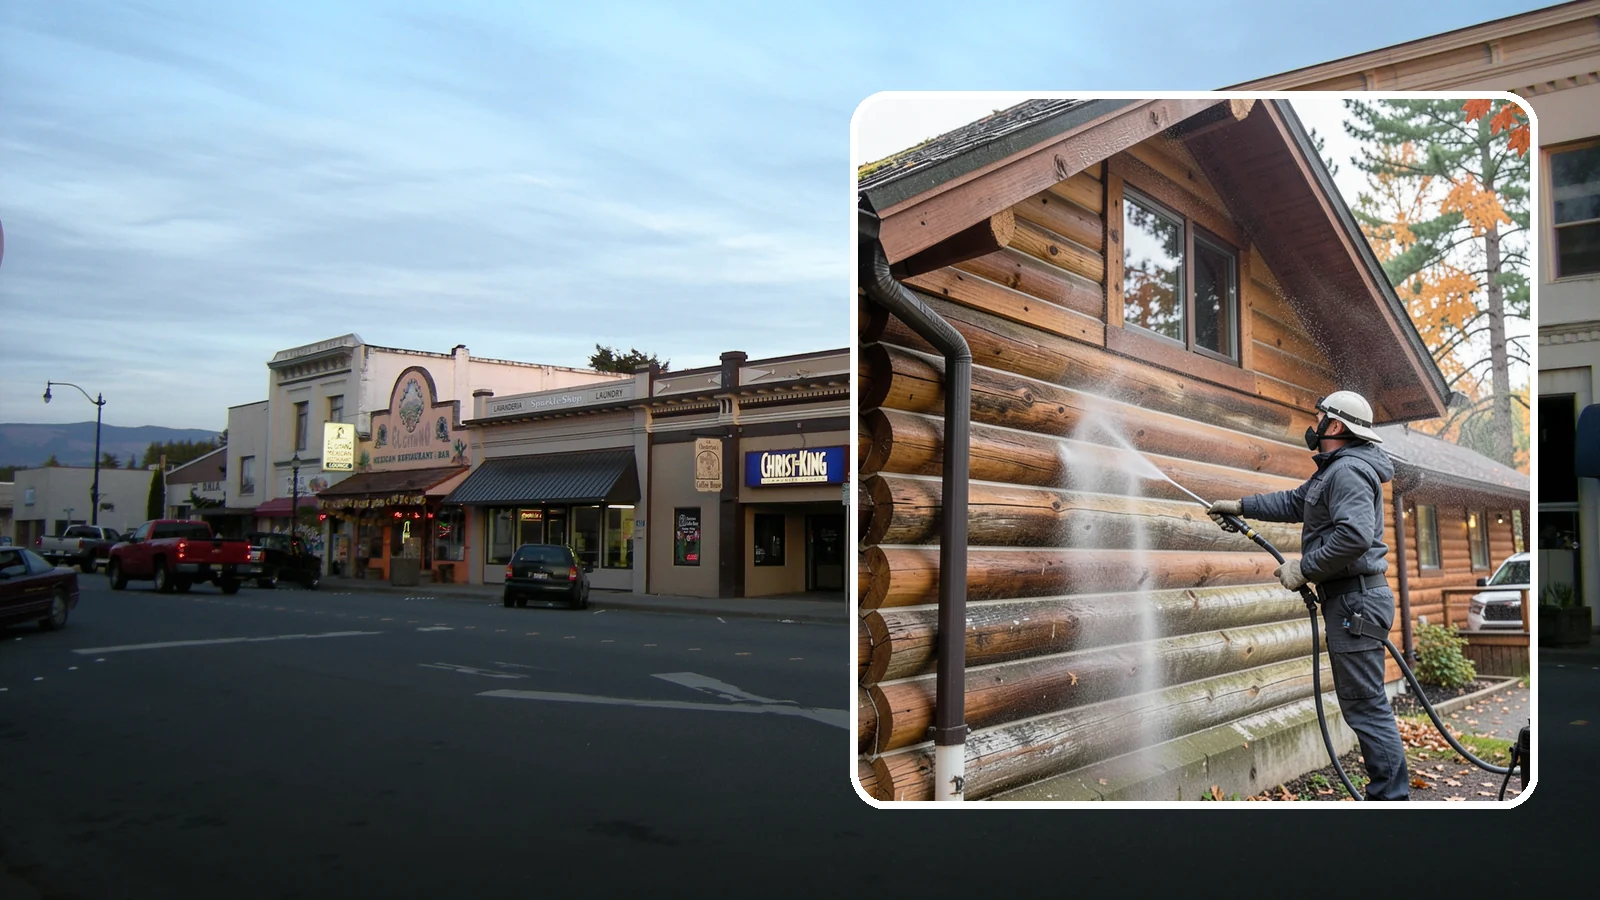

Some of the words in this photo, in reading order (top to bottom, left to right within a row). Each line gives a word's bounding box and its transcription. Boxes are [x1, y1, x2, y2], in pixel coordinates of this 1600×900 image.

[493, 402, 522, 412] LAVANDERIA
[595, 389, 623, 400] LAUNDRY
[397, 451, 433, 462] RESTAURANT
[438, 450, 450, 459] BAR
[761, 452, 798, 478] CHRIST
[799, 450, 827, 476] KING
